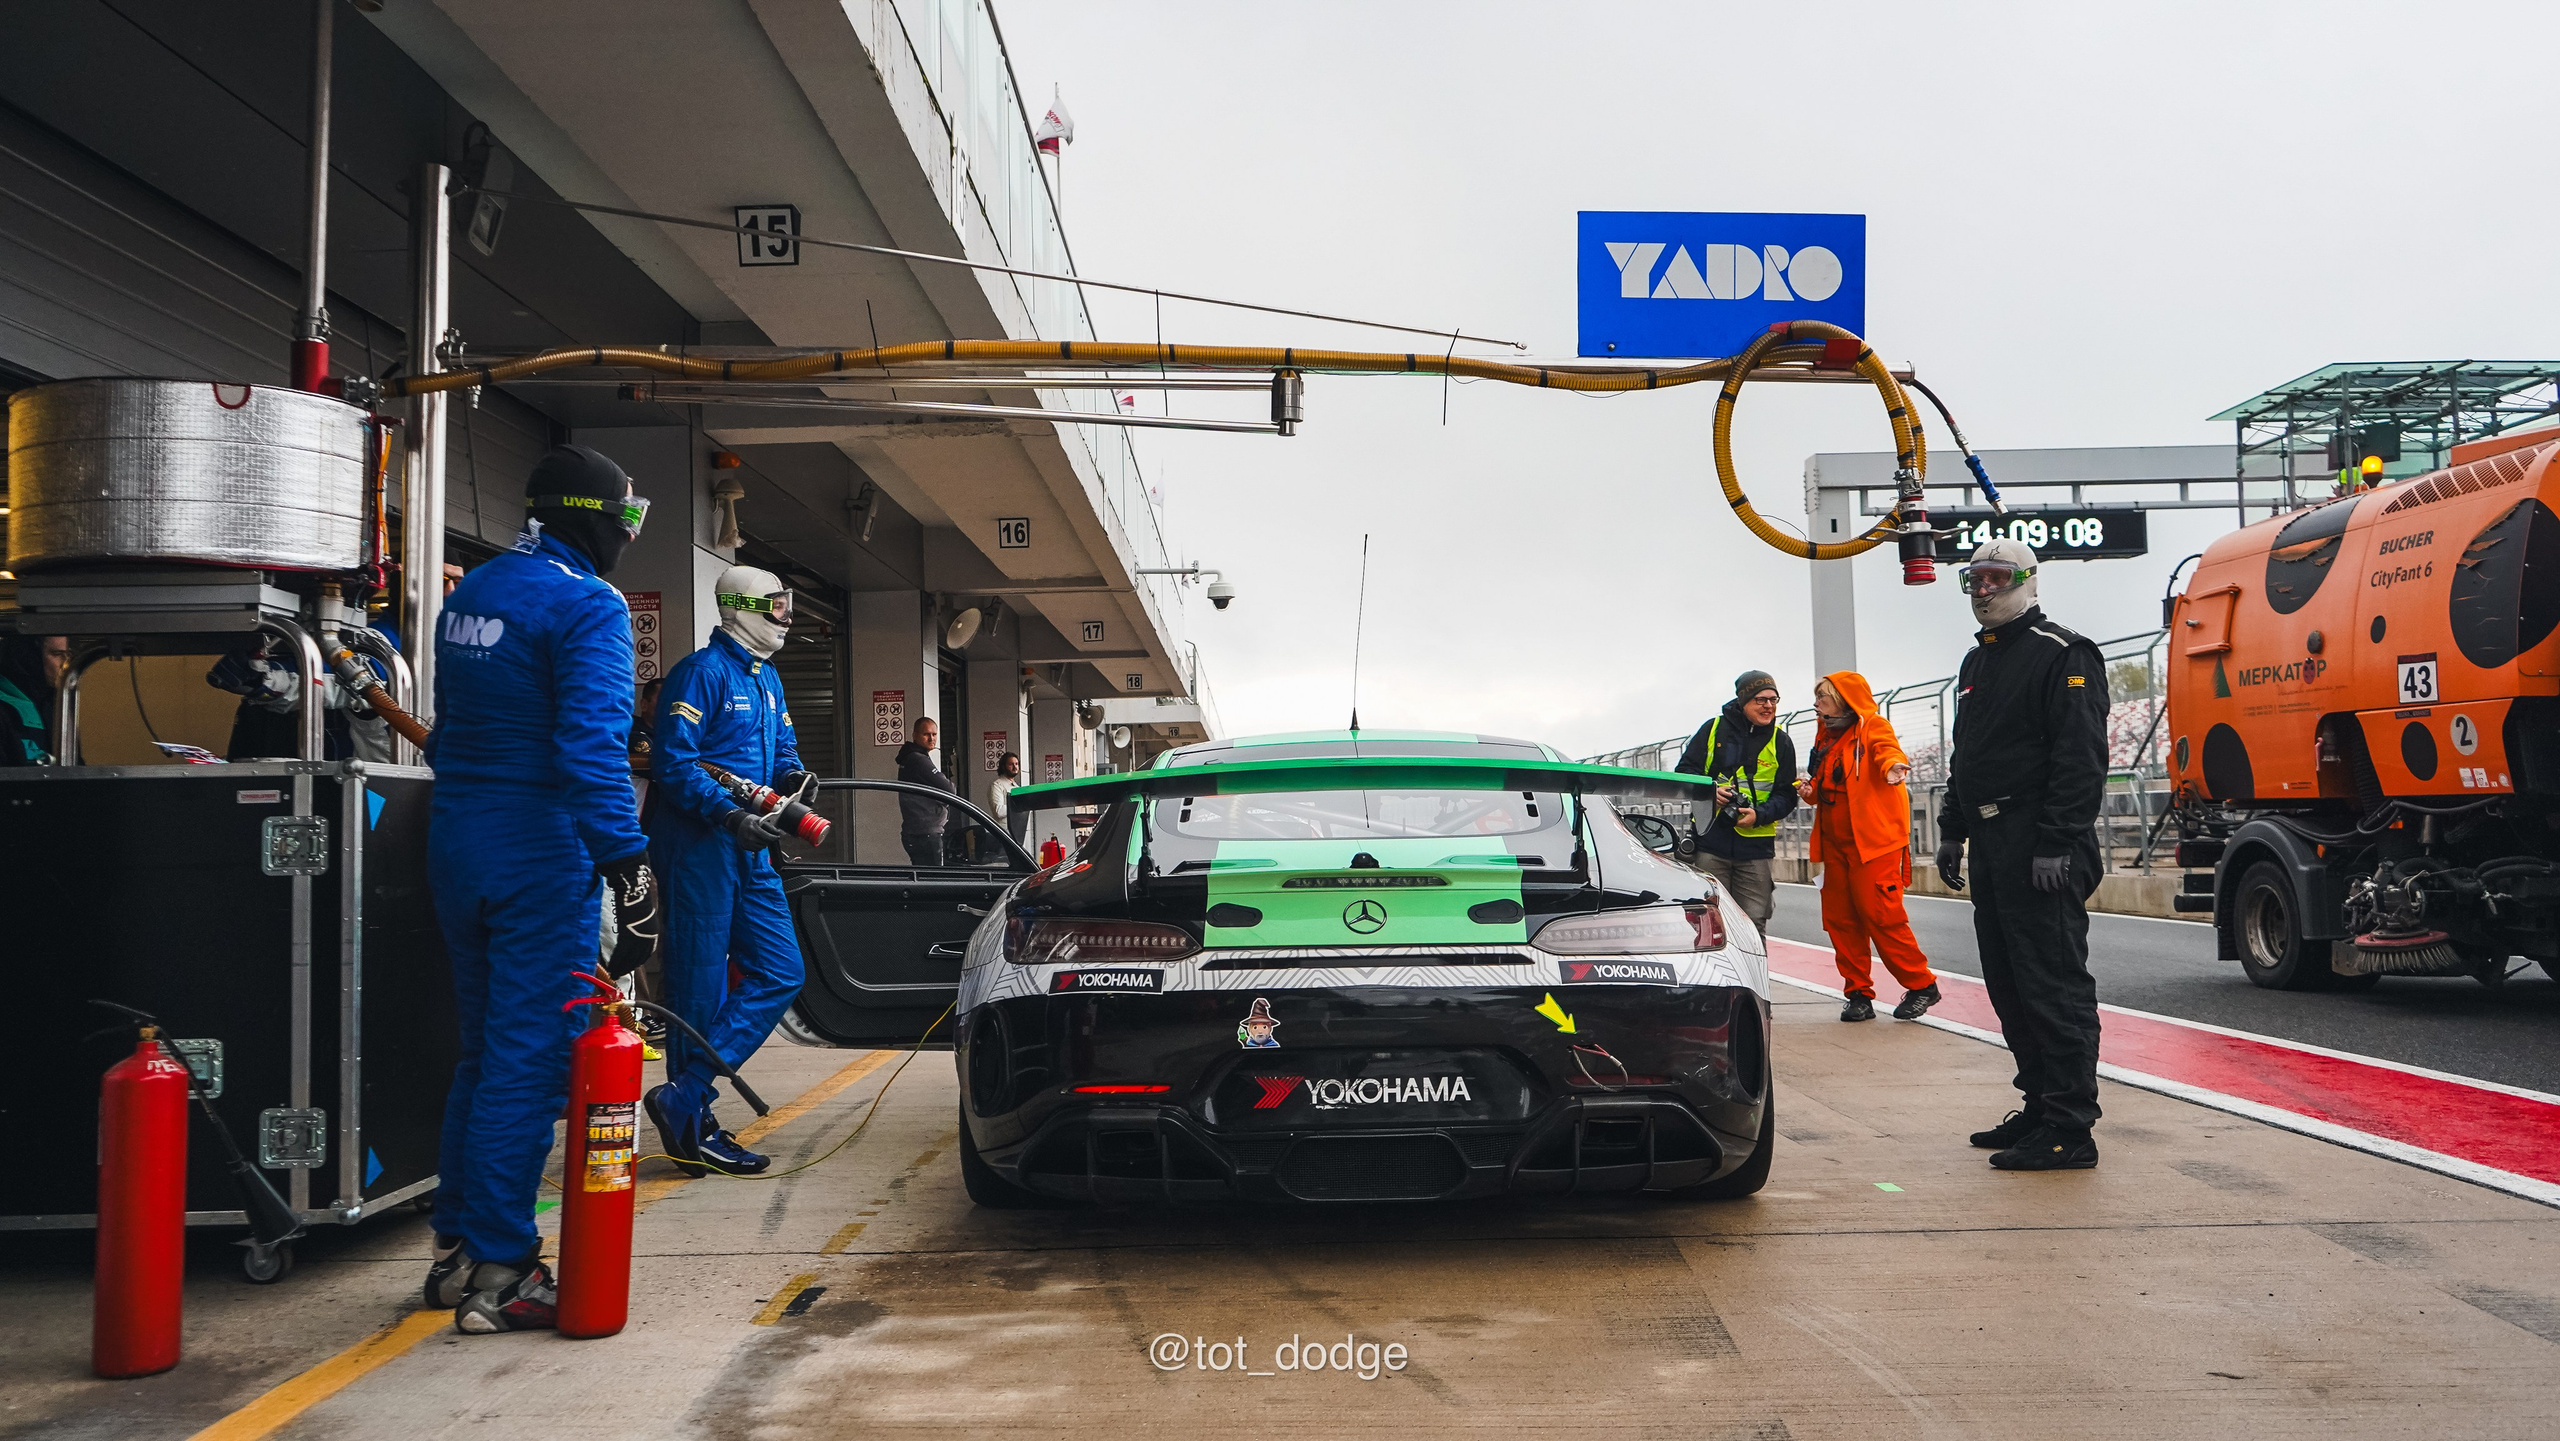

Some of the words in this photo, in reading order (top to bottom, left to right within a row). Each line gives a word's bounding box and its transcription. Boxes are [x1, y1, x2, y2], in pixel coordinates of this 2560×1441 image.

[743, 215, 790, 258] 15
[1604, 241, 1844, 302] YADRO
[563, 496, 603, 510] uvex
[1002, 522, 1026, 544] 16
[1956, 517, 2104, 550] 14:09:08
[2379, 530, 2434, 555] BUCHER
[2371, 564, 2422, 589] CityFant
[2424, 561, 2433, 577] 6
[1085, 625, 1100, 639] 17
[1128, 676, 1140, 688] 18
[2067, 677, 2085, 686] OMP
[2404, 665, 2433, 699] 43
[2455, 716, 2473, 747] 2
[1078, 973, 1154, 988] YOKOHAMA
[1594, 964, 1671, 980] YOKOHAMA
[1304, 1076, 1472, 1104] YOKOHAMA
